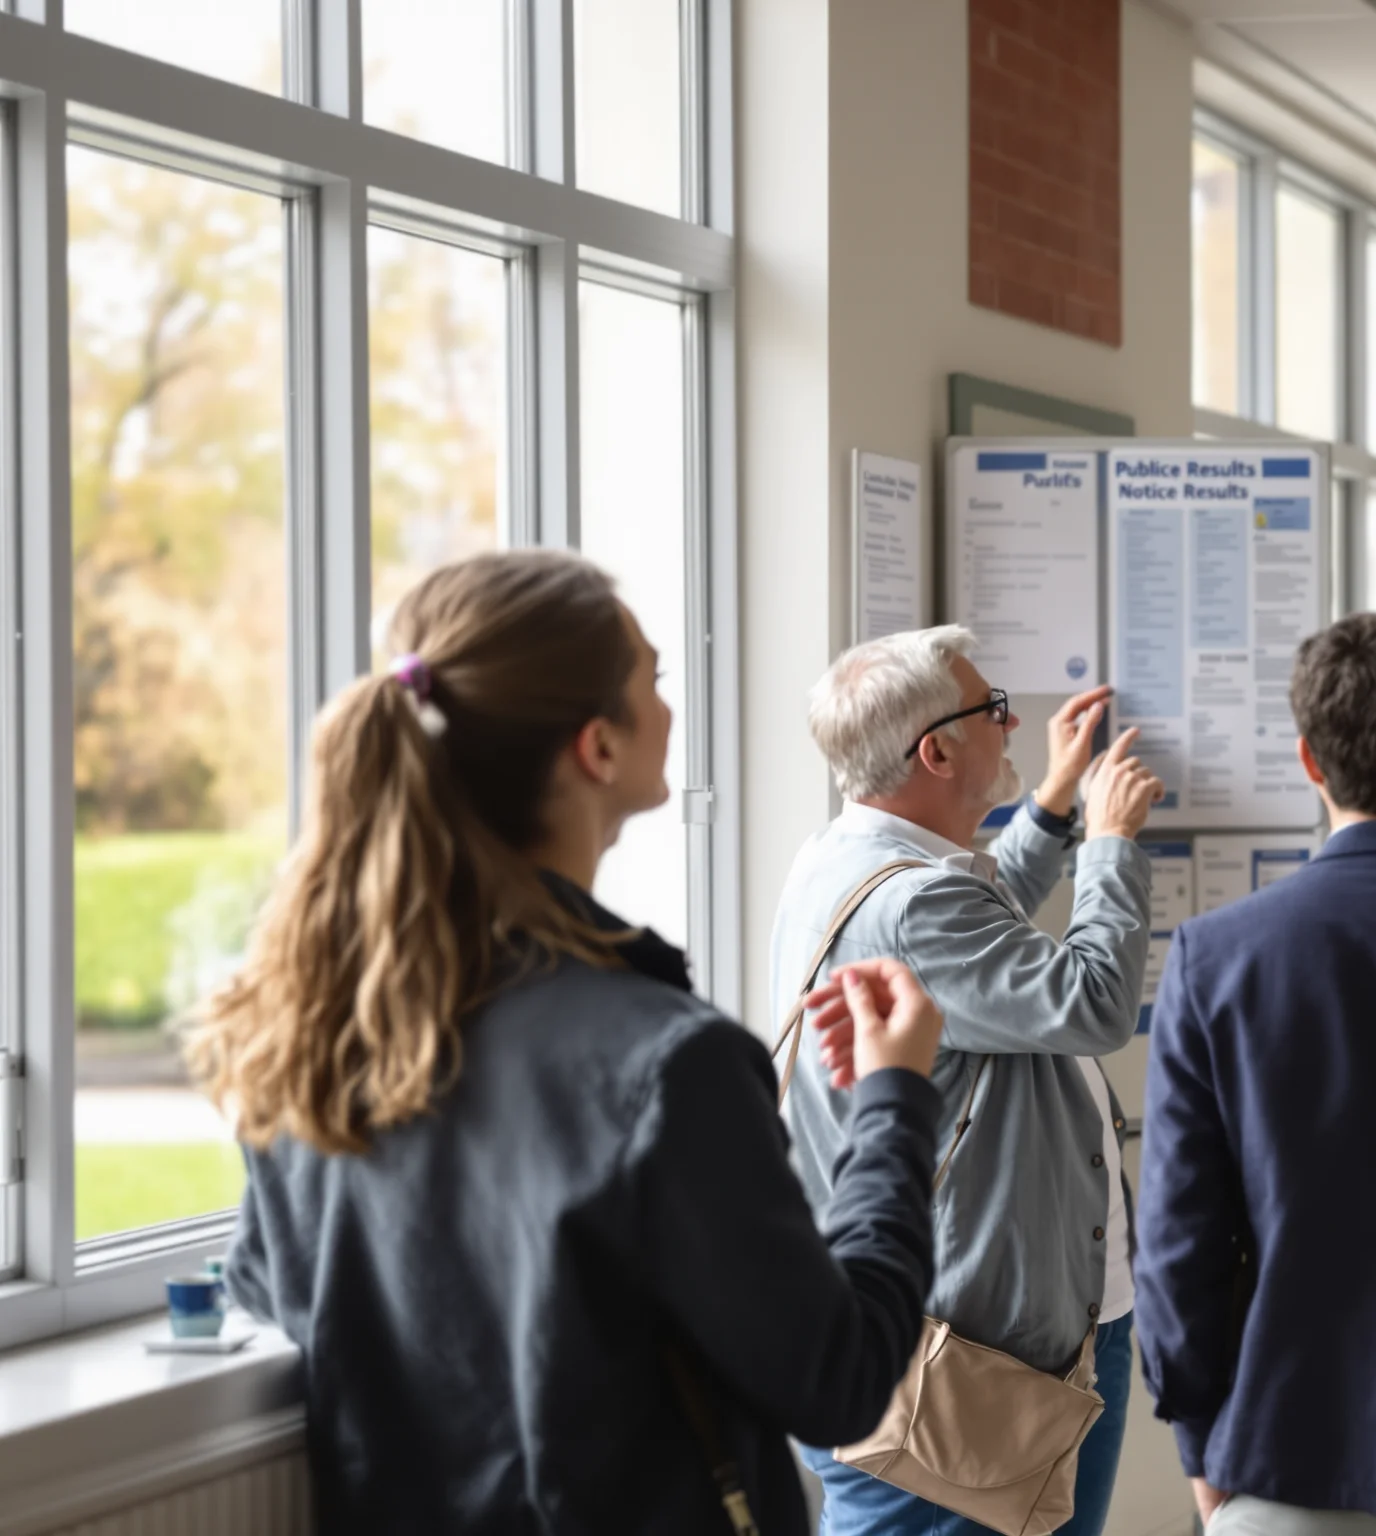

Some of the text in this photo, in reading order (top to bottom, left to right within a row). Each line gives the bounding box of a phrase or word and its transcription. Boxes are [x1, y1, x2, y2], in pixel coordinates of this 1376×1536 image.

[1116, 461, 1256, 477] Publice Results
[1119, 484, 1248, 500] Notice Results
